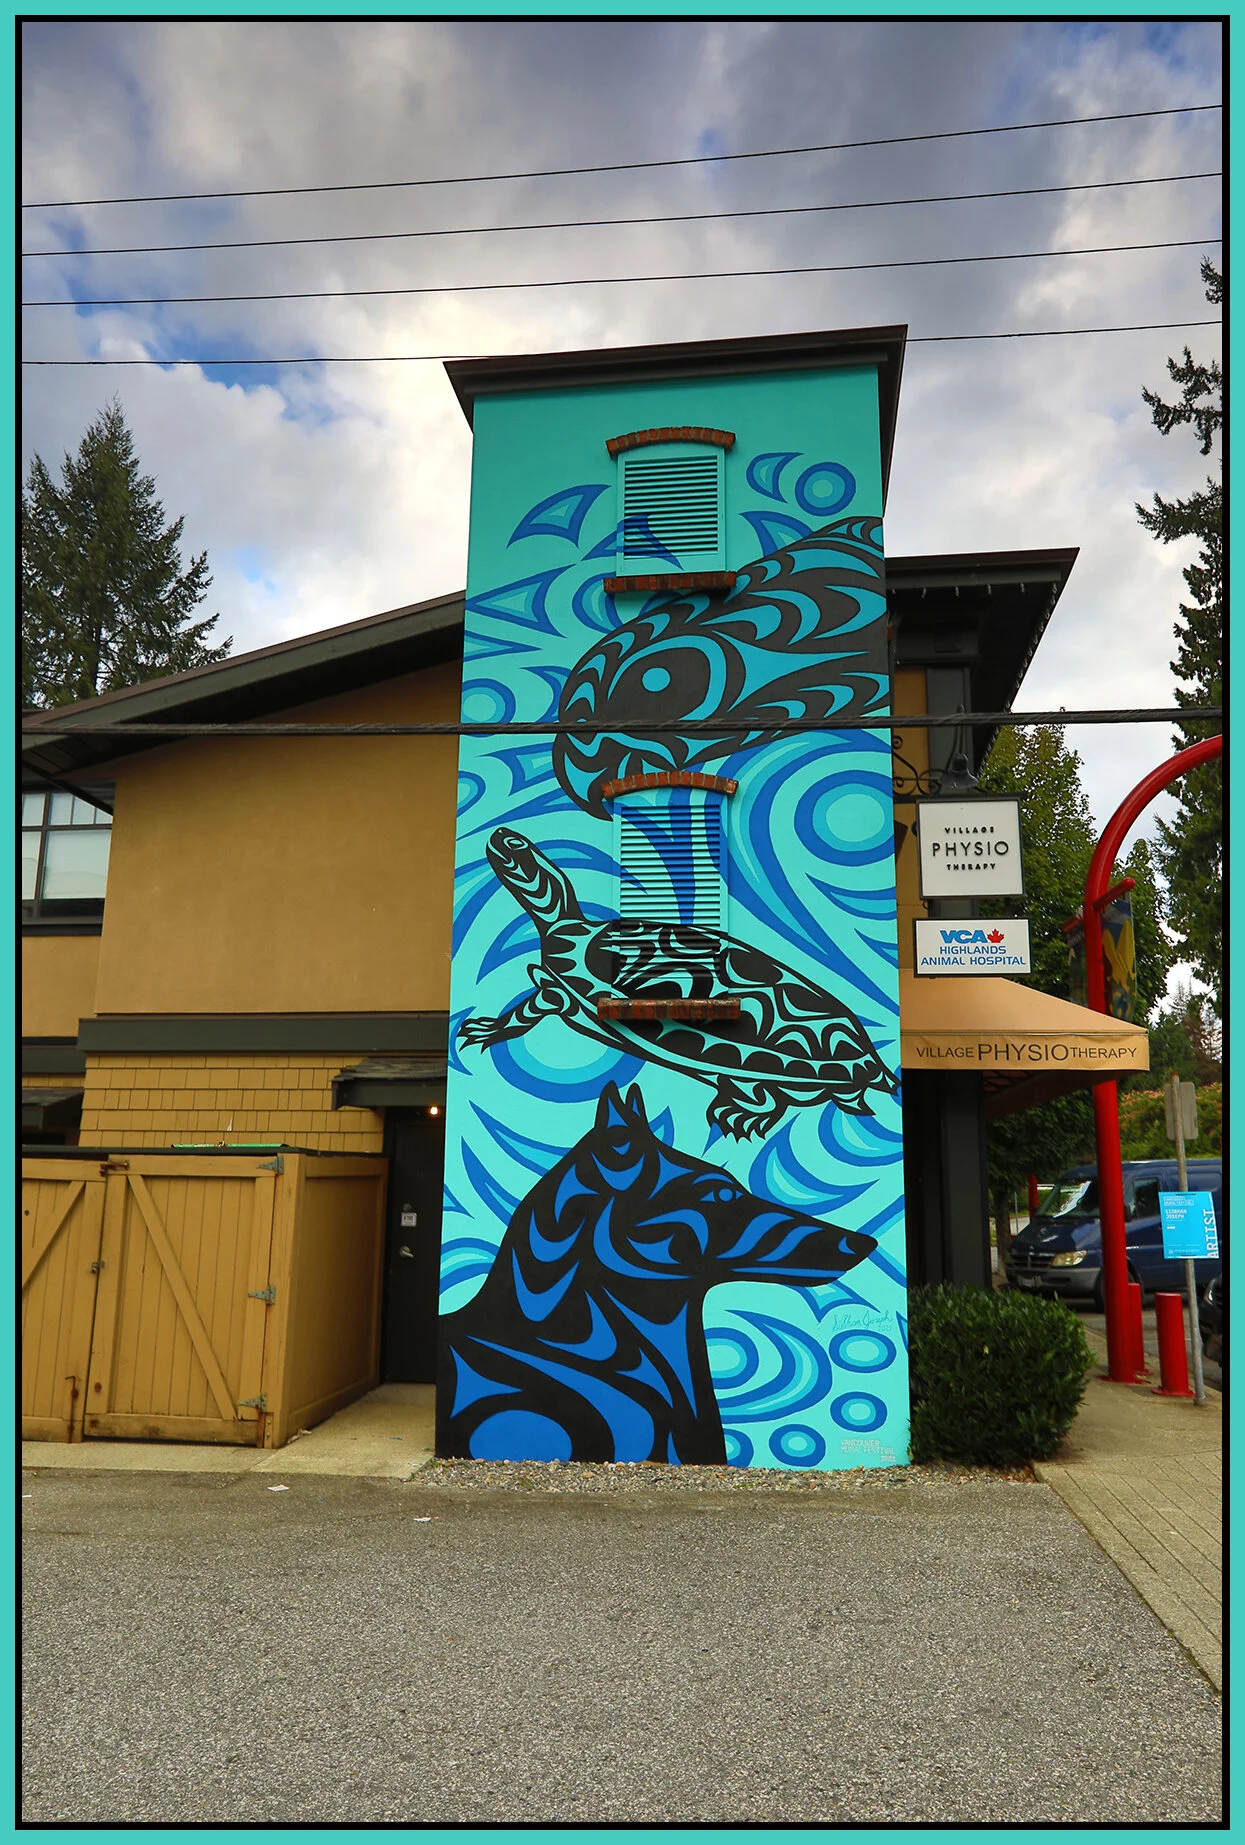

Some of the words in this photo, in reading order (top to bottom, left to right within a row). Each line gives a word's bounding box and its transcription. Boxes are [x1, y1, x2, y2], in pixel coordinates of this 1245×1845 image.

[944, 826, 995, 834] VILLAGE
[932, 840, 1009, 857] PHYSIO
[946, 863, 996, 871] THERAPY
[939, 929, 988, 944] VCA
[939, 945, 1007, 955] HIGHLANDS
[920, 956, 966, 966] ANIMAL
[969, 956, 1026, 965] HOSPITAL
[916, 1046, 975, 1058] VILLAGE
[1202, 1208, 1219, 1259] ARTIST
[840, 1439, 880, 1447] VANCOUVER
[840, 1446, 861, 1454] MURAL
[863, 1446, 895, 1455] FESTIVAL
